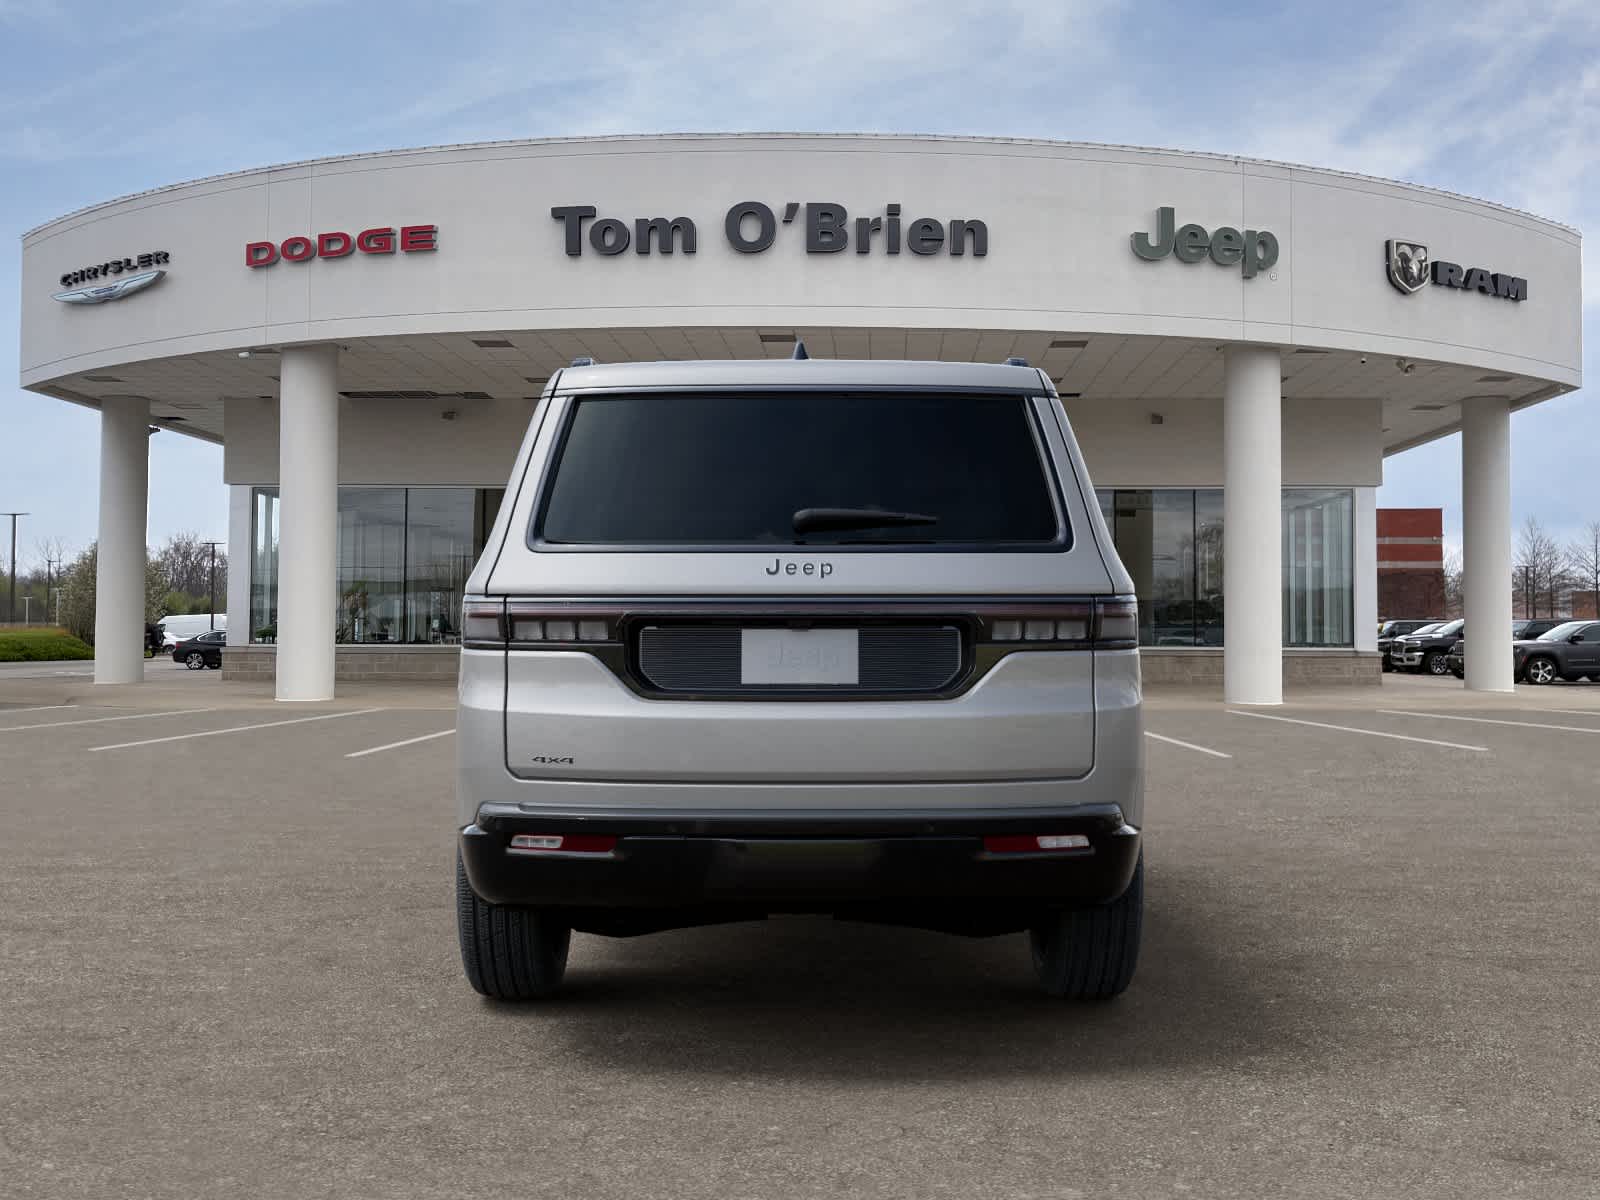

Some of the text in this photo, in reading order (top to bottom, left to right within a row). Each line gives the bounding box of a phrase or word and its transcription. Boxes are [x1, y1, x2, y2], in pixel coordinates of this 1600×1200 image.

[245, 225, 438, 268] DODGE
[551, 201, 988, 257] Tom O'Brien
[1130, 206, 1280, 279] Jeep
[60, 250, 170, 287] CHRYSLER
[1430, 260, 1528, 301] RAM
[765, 558, 834, 579] Jeep
